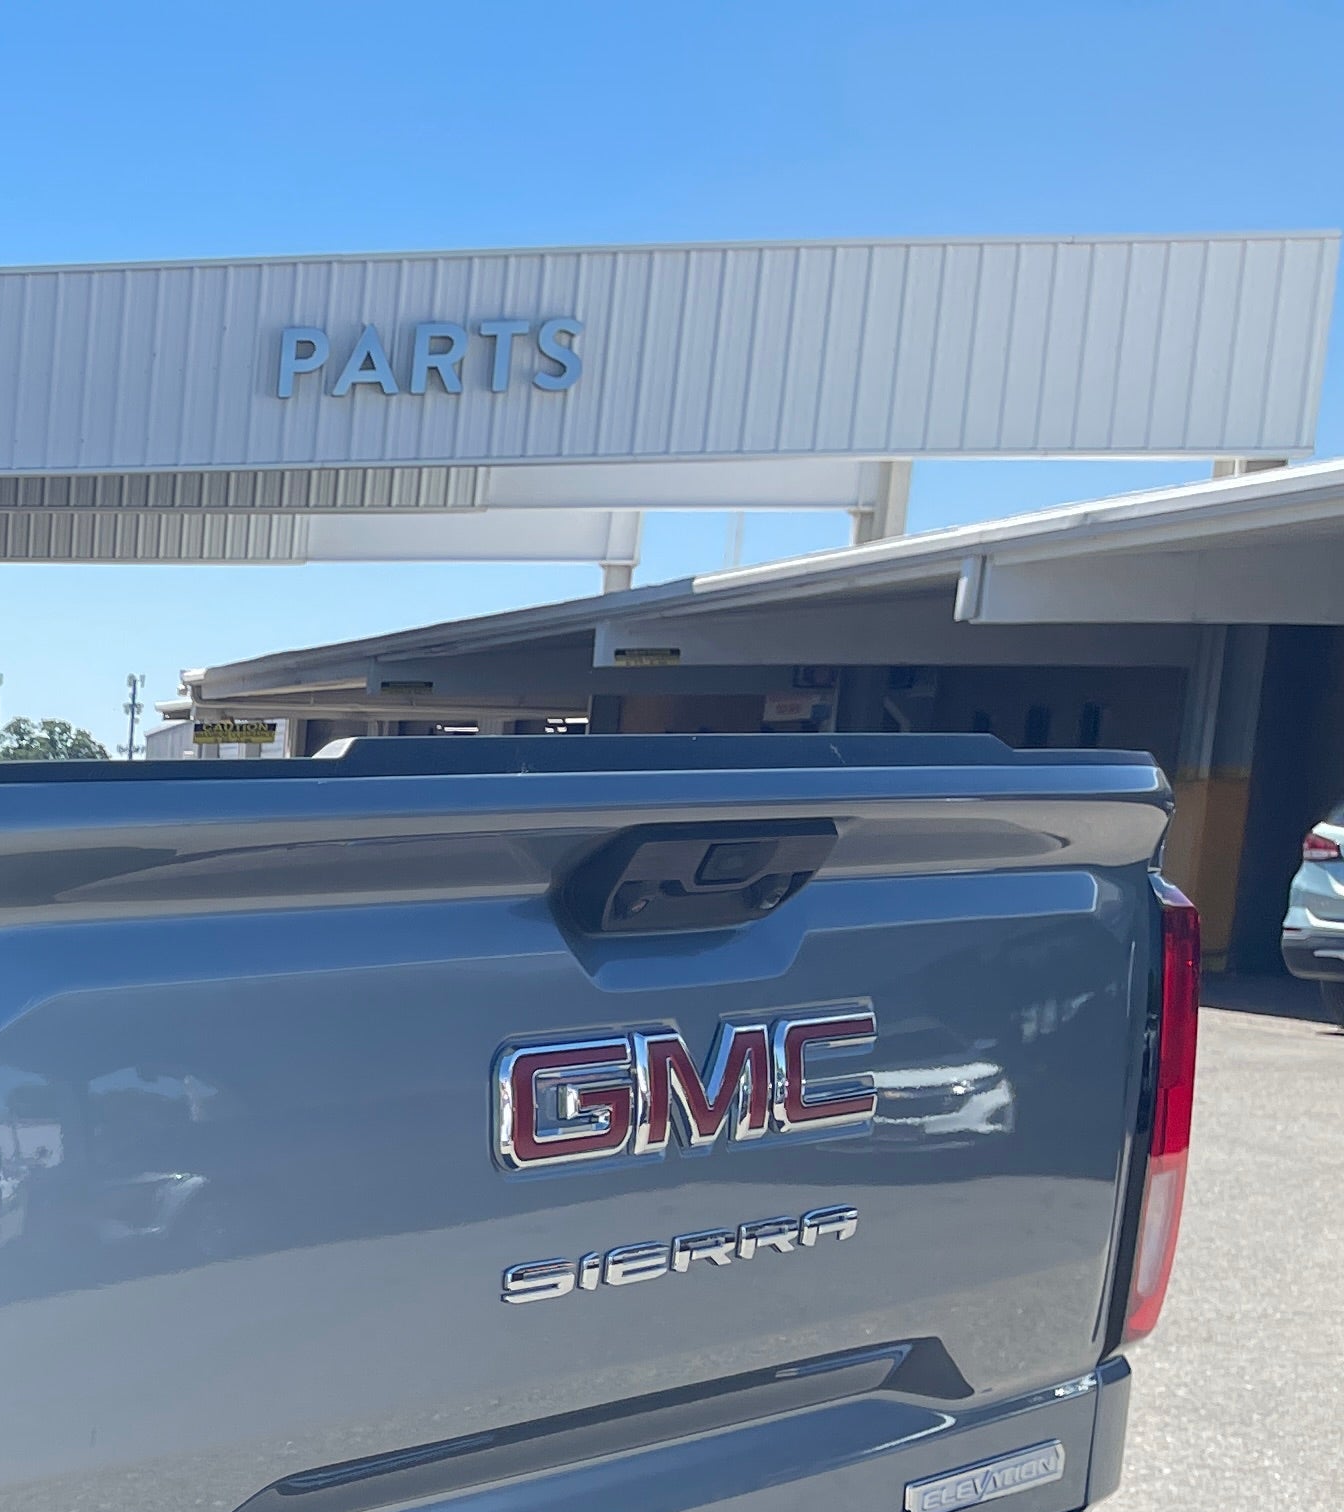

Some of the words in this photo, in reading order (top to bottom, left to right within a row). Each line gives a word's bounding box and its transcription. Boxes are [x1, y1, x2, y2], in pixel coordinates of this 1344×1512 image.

[277, 317, 585, 398] PARTS
[491, 1011, 878, 1170] GMC
[500, 1203, 859, 1304] SIERRA
[921, 1450, 1062, 1512] ELEVATION
